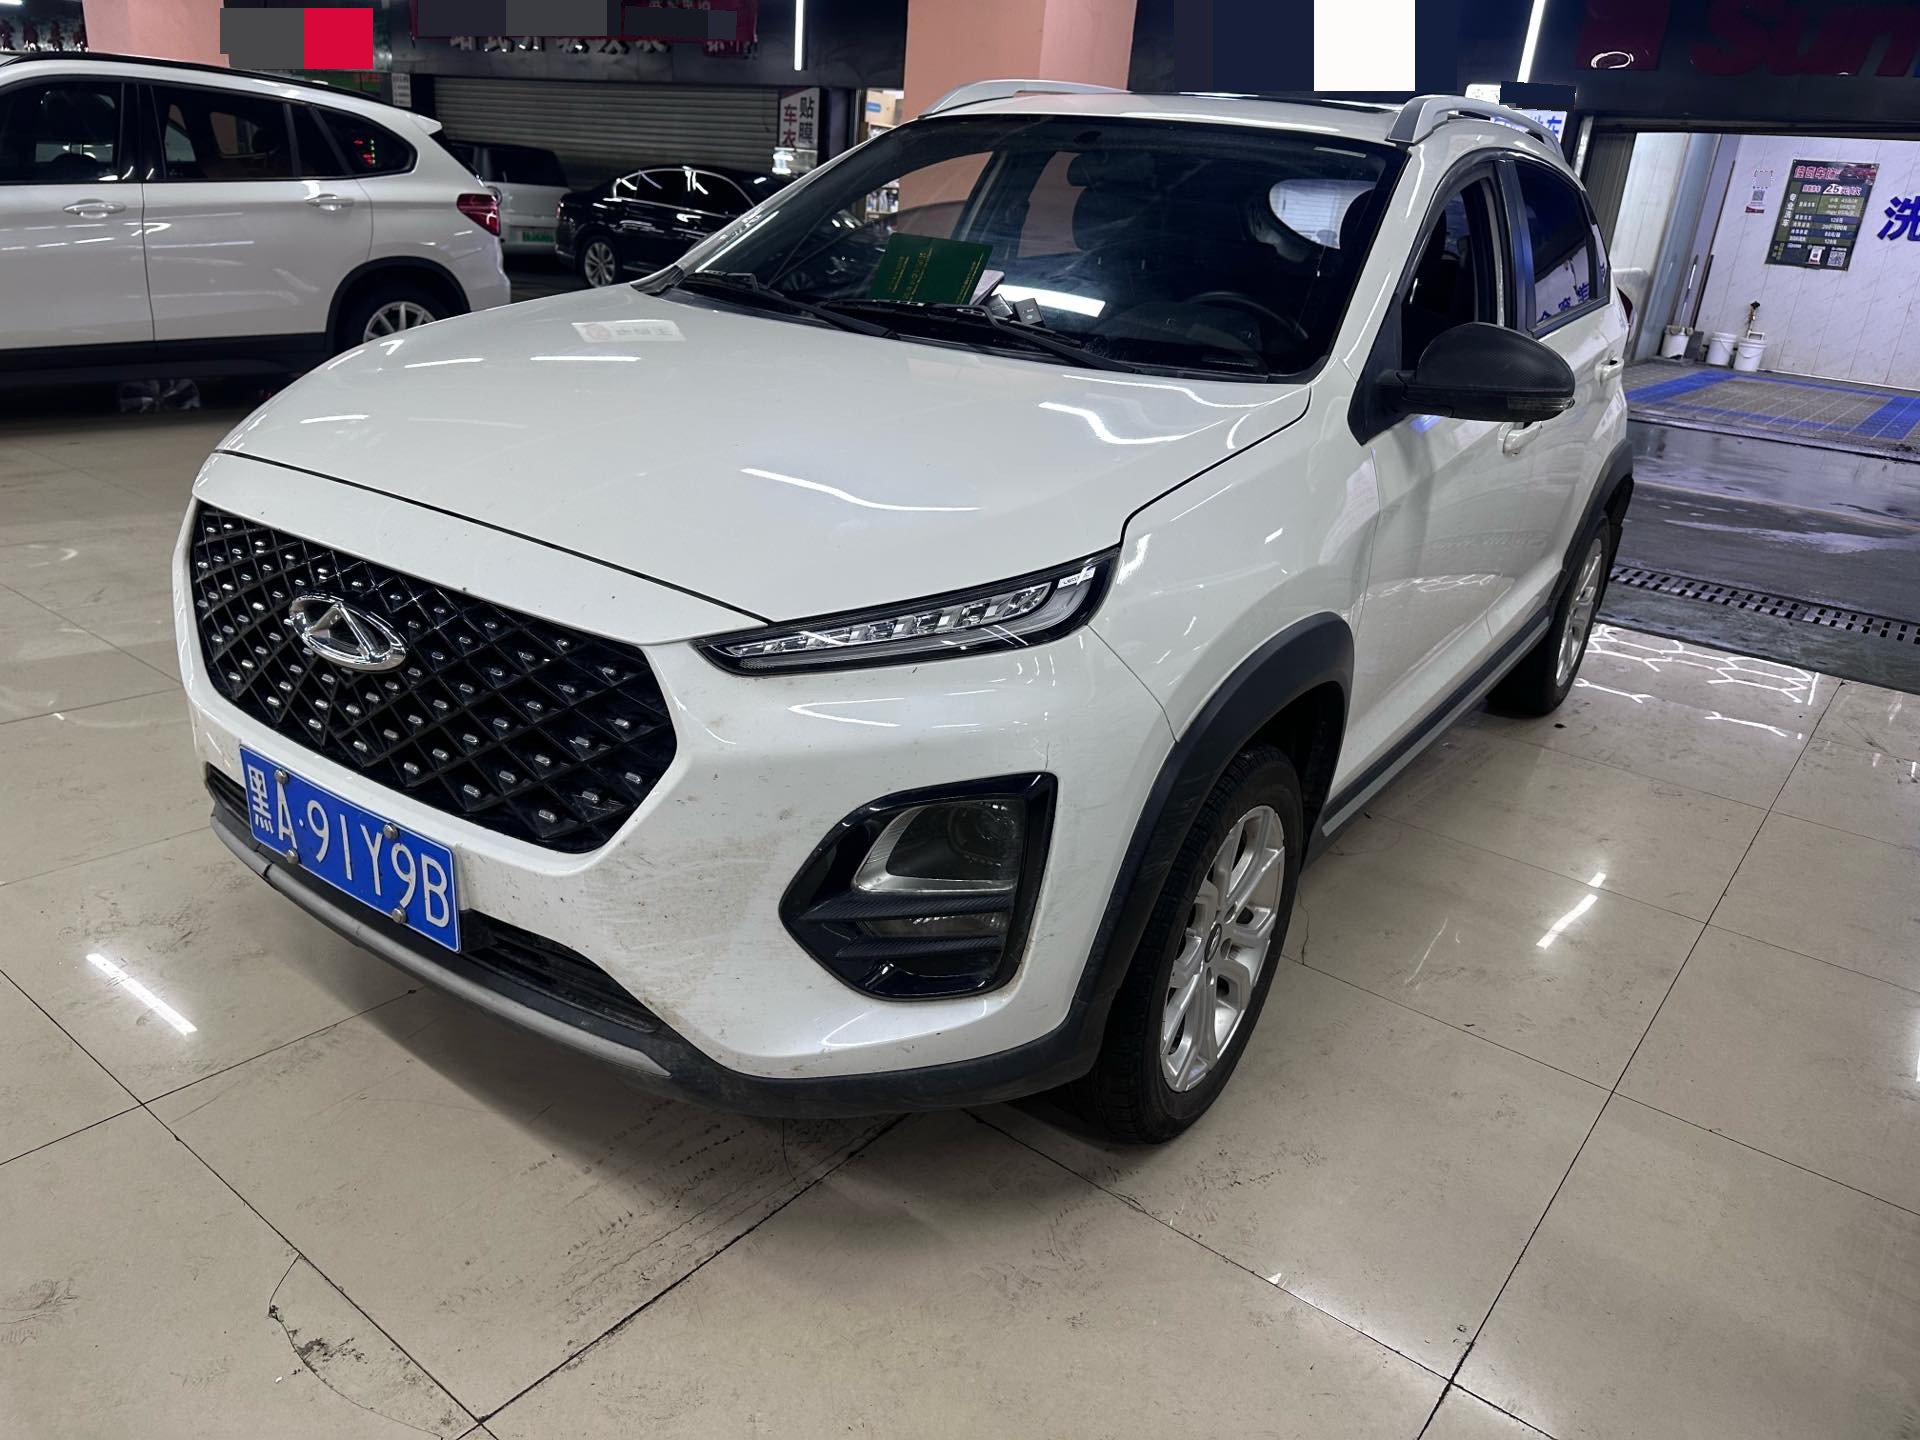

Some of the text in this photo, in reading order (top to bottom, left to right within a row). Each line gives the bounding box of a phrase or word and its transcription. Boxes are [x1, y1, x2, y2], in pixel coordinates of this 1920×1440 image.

[1688, 0, 1920, 77] Sun
[783, 104, 797, 149] 车衣
[799, 96, 815, 144] 贴膜
